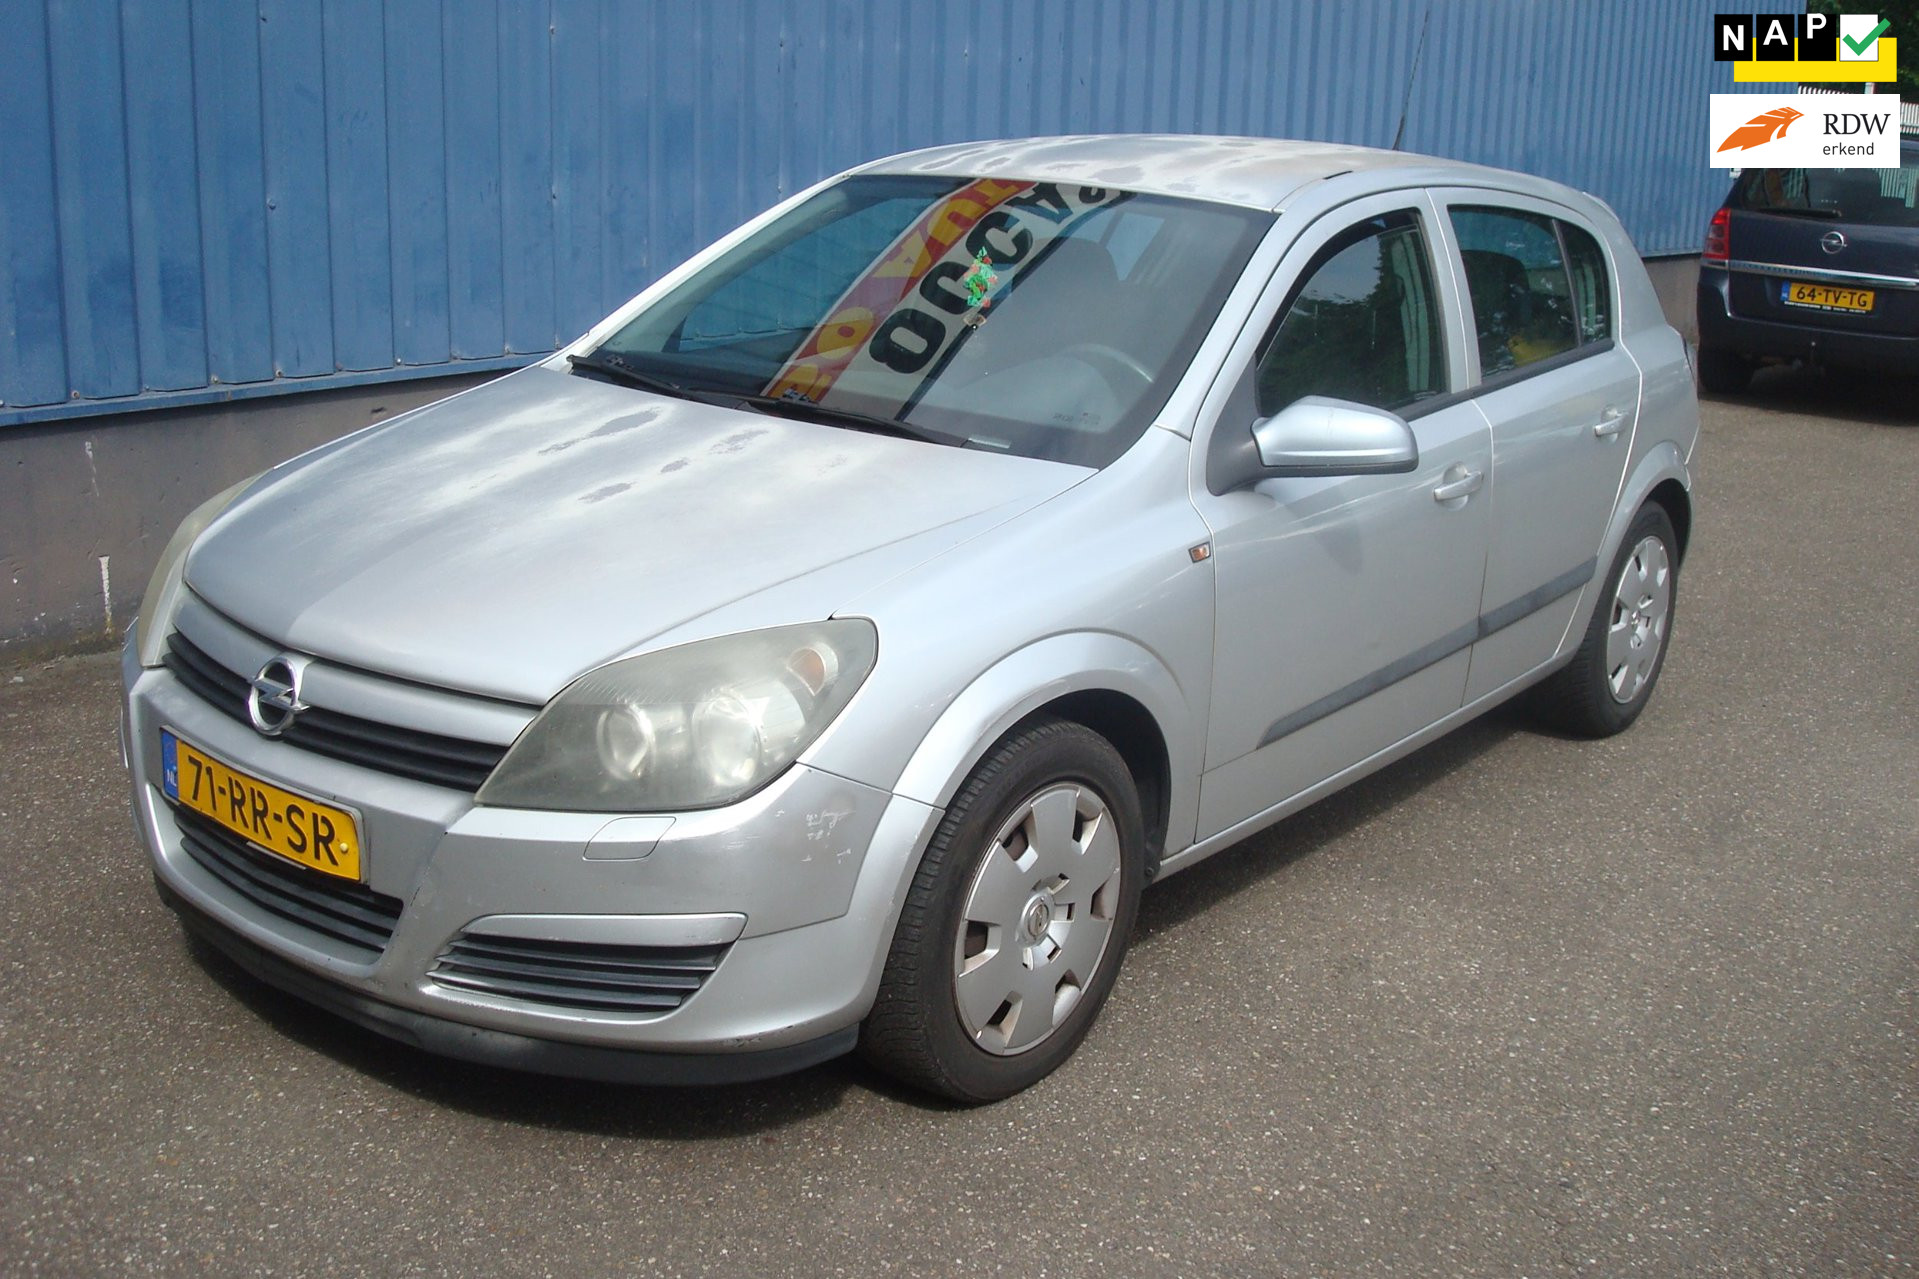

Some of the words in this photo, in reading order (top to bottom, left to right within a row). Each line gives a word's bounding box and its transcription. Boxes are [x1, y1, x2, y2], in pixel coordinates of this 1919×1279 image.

[1796, 286, 1868, 307] 64-TV-TG
[166, 768, 177, 787] NL
[187, 754, 339, 866] 71-RR-SR
